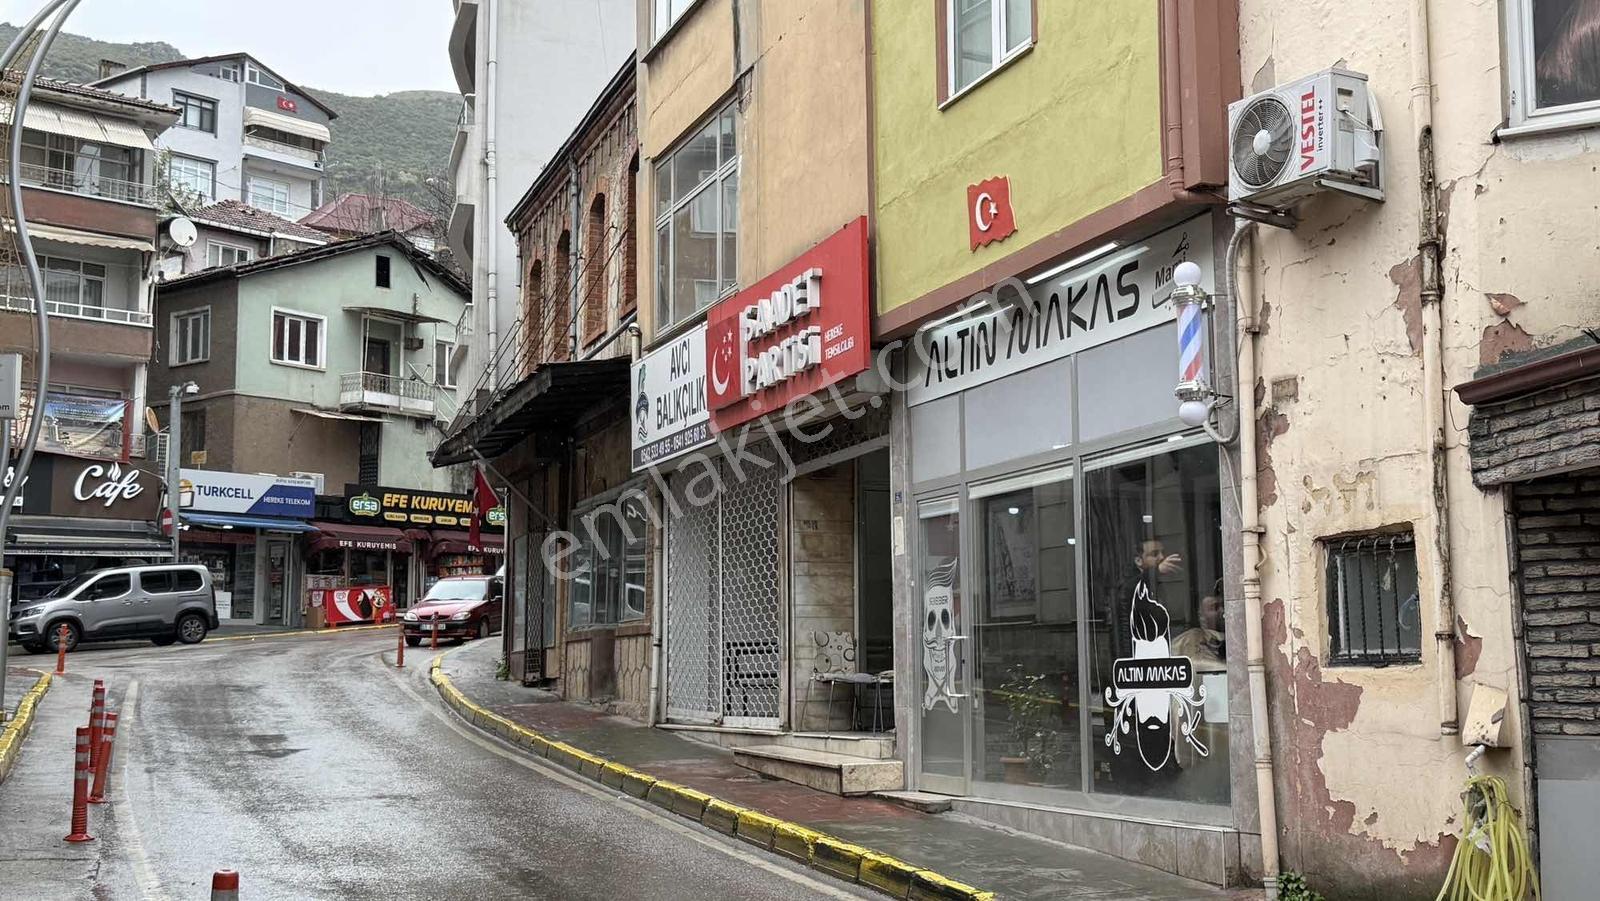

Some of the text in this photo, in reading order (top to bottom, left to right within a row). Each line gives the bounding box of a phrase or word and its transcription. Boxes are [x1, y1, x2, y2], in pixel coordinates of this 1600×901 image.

[1301, 86, 1315, 171] VESTEL
[739, 267, 823, 343] SAADET
[925, 260, 1141, 388] ALTIN MAKAS
[670, 338, 690, 382] AVCI
[656, 375, 706, 430] BALIKÇILIK
[74, 465, 144, 507] Cafe
[196, 485, 254, 500] TURKCELL
[285, 497, 311, 506] TELEKOM
[352, 499, 378, 512] ersa
[383, 493, 408, 509] EFE
[1117, 665, 1187, 682] ALTIN MAKAS
